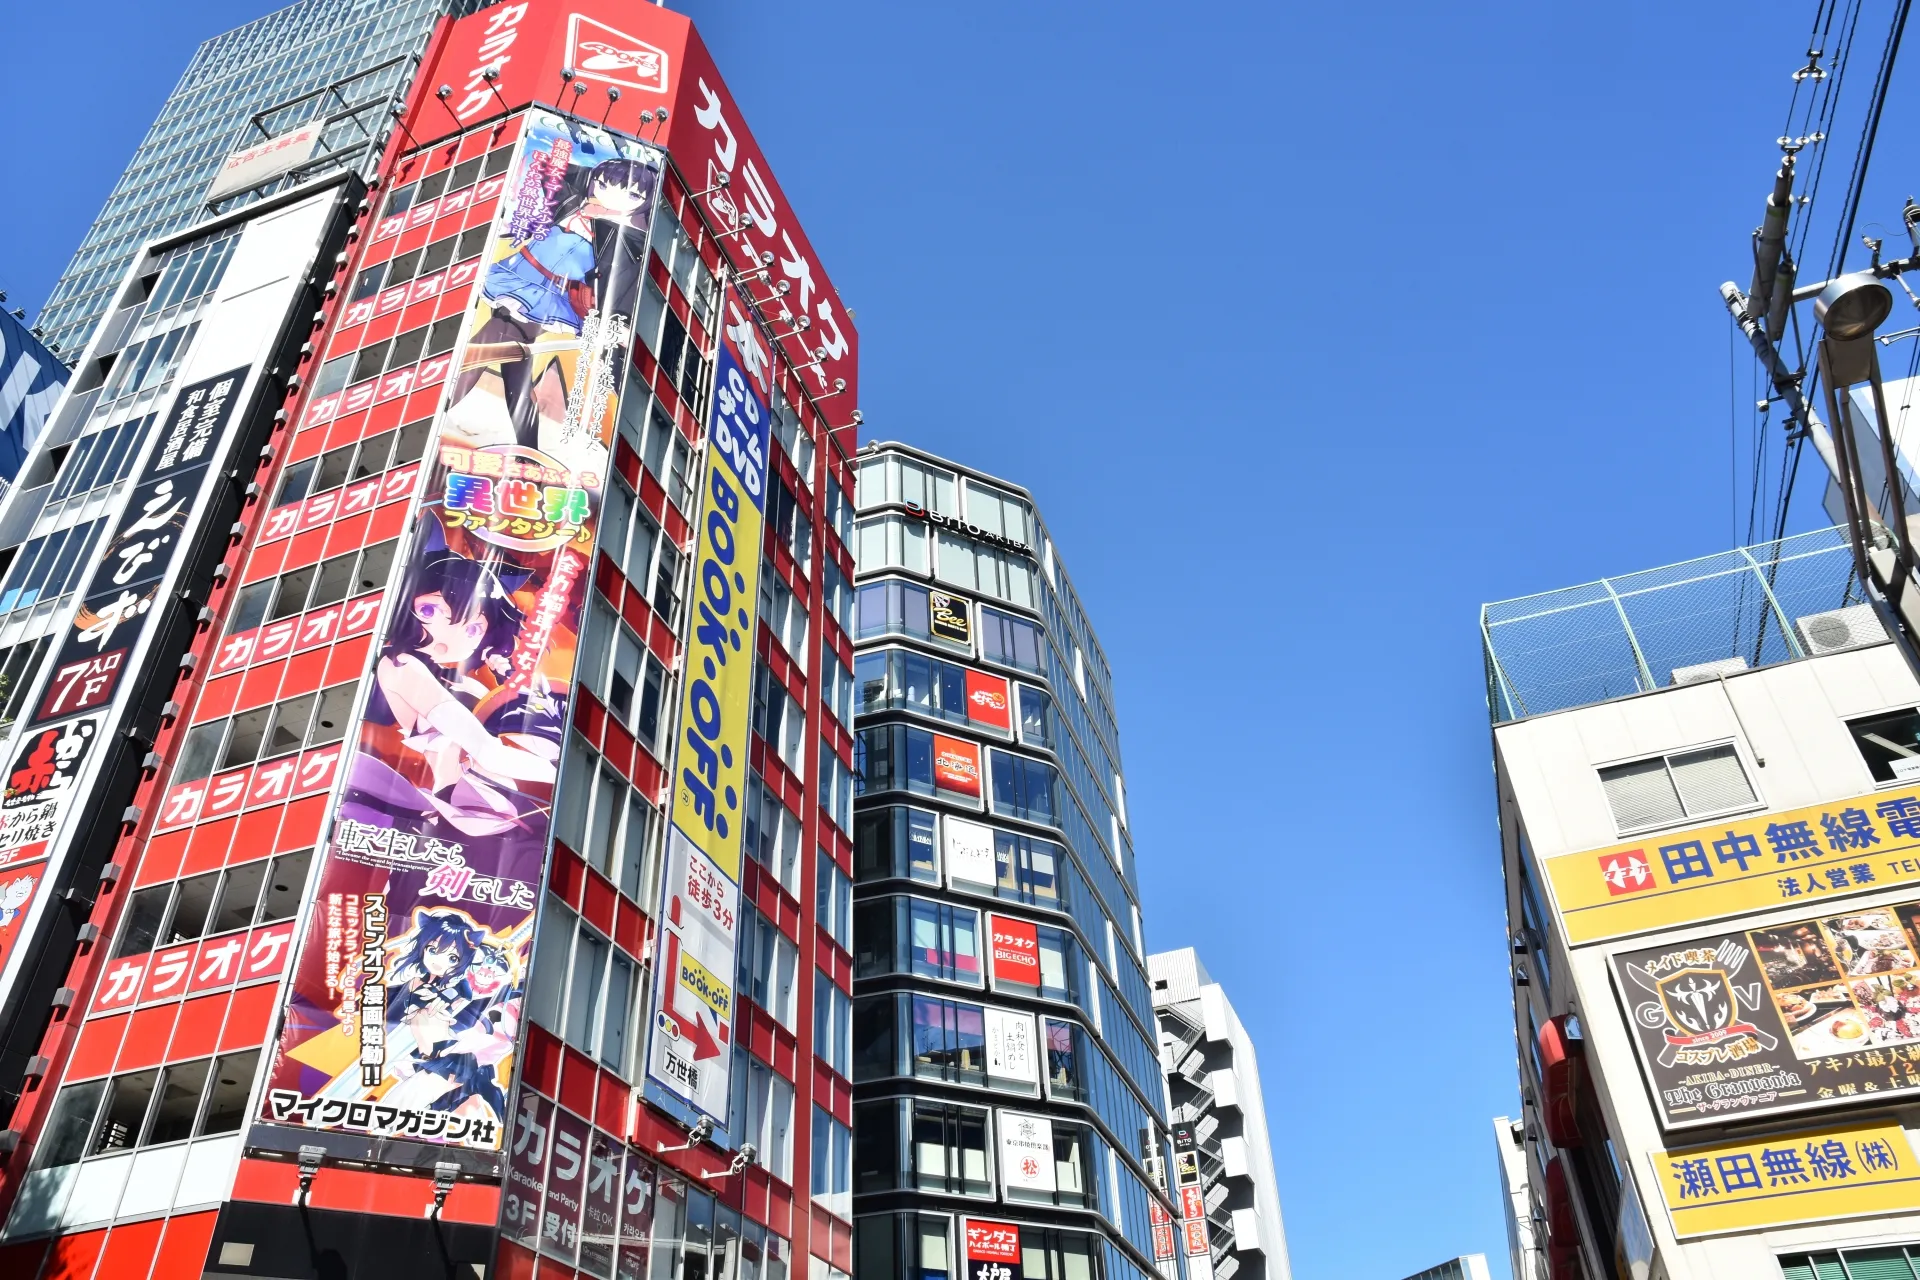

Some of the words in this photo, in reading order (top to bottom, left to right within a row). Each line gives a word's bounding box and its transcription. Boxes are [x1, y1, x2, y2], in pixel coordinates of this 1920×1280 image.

[456, 2, 529, 121] カラオケ
[227, 131, 312, 171] 広告主募集
[376, 176, 505, 240] カラオケ
[693, 76, 849, 361] カラオケ
[343, 260, 481, 327] カラオケ
[726, 300, 769, 395] 本
[310, 357, 450, 425] カラオケ
[155, 389, 206, 472] 和食居酒屋
[182, 377, 235, 462] 個室完備
[441, 445, 599, 488] 可愛さあふれる
[715, 414, 761, 496] DVD
[265, 468, 419, 539] カラオケ
[444, 473, 590, 524] 異世界
[218, 598, 381, 669] カラオケ
[933, 607, 967, 627] Bee
[84, 652, 122, 676] 入口
[51, 664, 107, 714] 7F
[163, 751, 339, 824] カラオケ
[338, 820, 466, 868] 転生したら
[1658, 796, 1920, 885] 田中無線電
[419, 863, 537, 911] 剣でした
[689, 854, 725, 898] ここから
[1777, 862, 1877, 898] 法人営業
[686, 874, 734, 931] 徒歩3分
[100, 929, 291, 1001] カラオケ
[325, 893, 343, 1000] 新たな旅が始まる!
[341, 893, 359, 1037] コミックライド6月号より
[993, 932, 1036, 949] カラオケ
[995, 949, 1012, 960] BIG
[1012, 953, 1037, 966] ECHO
[1645, 948, 1717, 976] メイド喫茶
[1006, 1032, 1016, 1070] 土鍋めし
[1015, 1021, 1025, 1060] 肉和食と
[1675, 1037, 1760, 1066] コスプレ酒場
[1692, 1034, 1709, 1044] since
[665, 1050, 699, 1091] 万世橋
[270, 1091, 497, 1144] マイクロマガジン社
[514, 1110, 652, 1215] カラオケ
[1022, 1158, 1038, 1175] 松
[507, 1165, 543, 1192] Karaoke
[547, 1190, 560, 1202] and
[560, 1192, 579, 1212] Party
[543, 1211, 578, 1249] 受付
[967, 1227, 1017, 1244] ギンダコ
[968, 1240, 1016, 1252] ハイボール横丁
